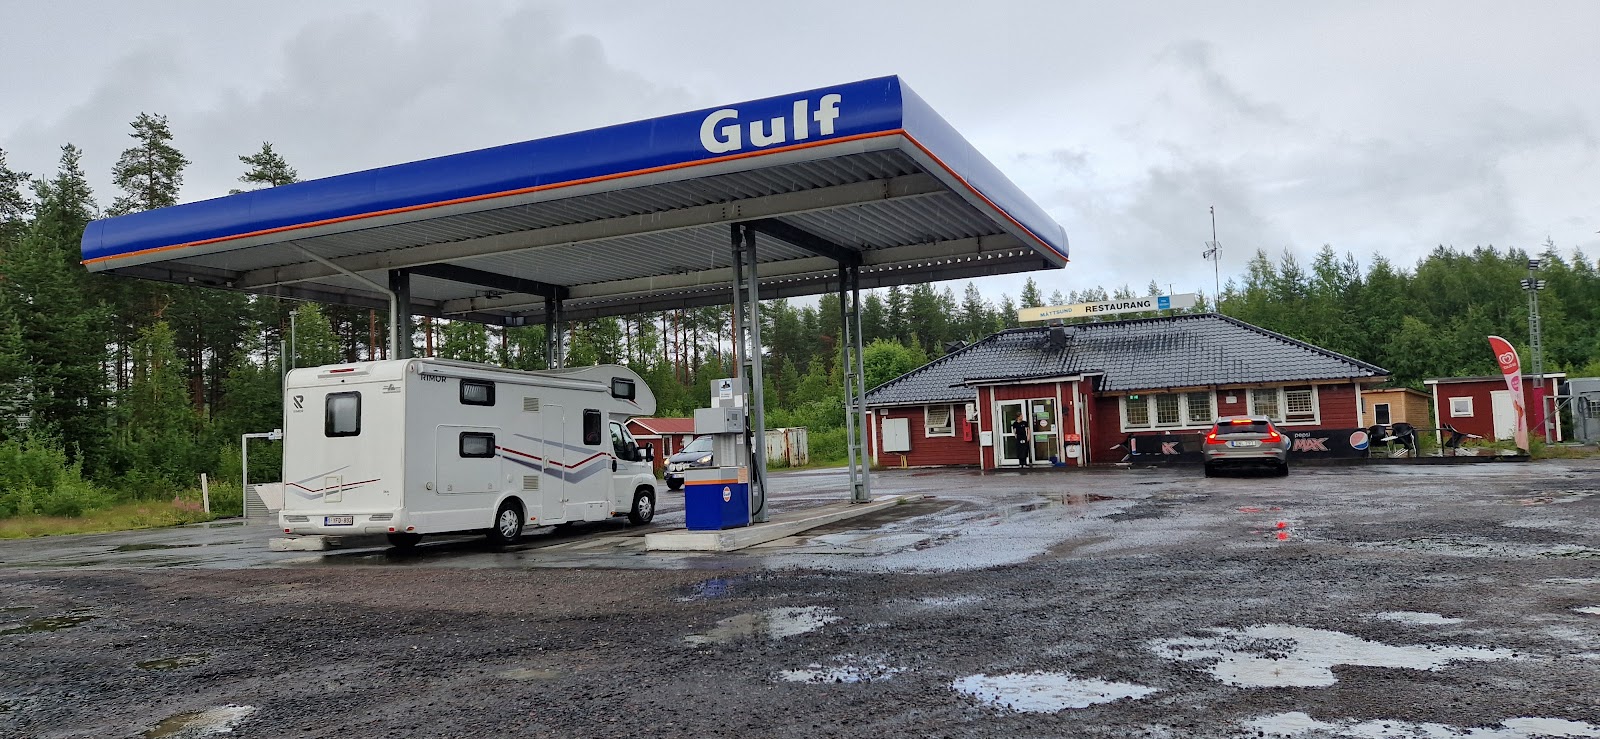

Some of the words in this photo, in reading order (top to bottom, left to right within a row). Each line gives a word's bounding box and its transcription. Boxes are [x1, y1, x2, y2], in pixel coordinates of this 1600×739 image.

[700, 94, 841, 153] Gulf
[1085, 300, 1151, 313] RESTAURANG
[1292, 437, 1329, 453] MAX
